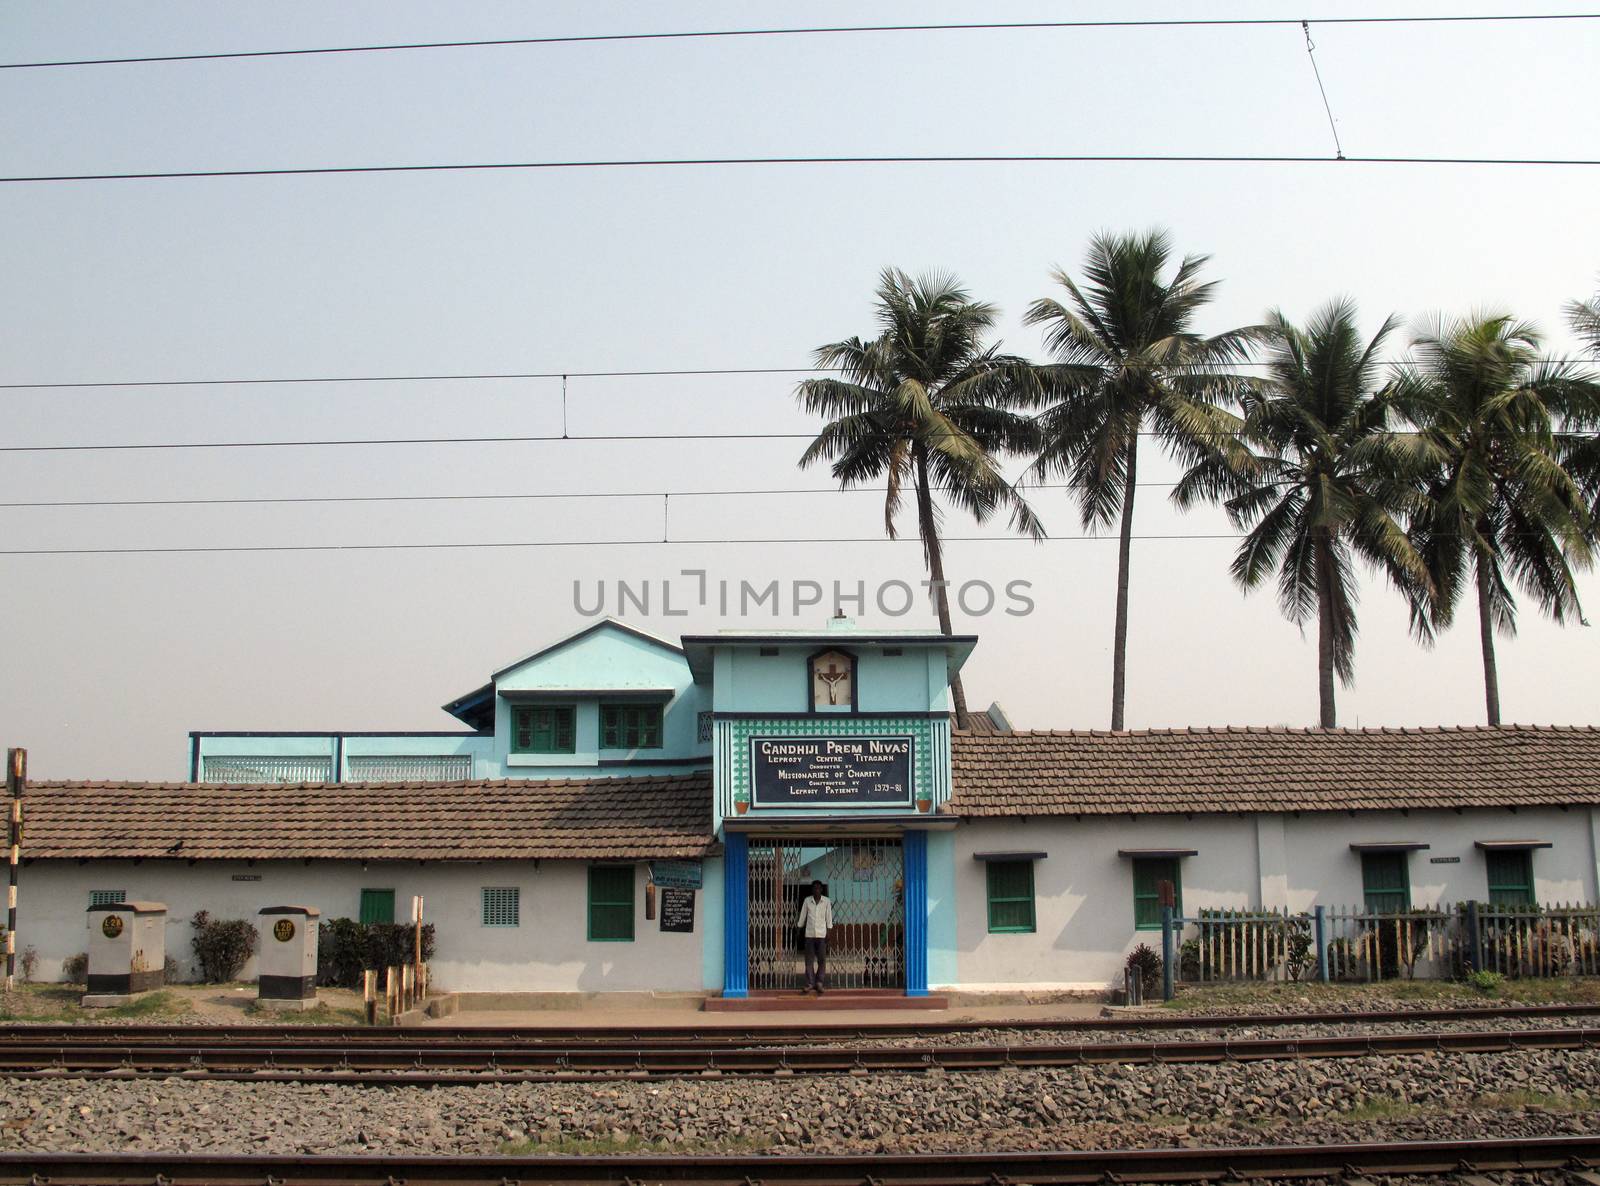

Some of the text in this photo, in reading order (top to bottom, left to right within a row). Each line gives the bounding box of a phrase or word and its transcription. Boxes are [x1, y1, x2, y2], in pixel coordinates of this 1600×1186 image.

[761, 740, 909, 755] GANDHIJI PREM NIVAS
[768, 755, 803, 763] LEPROSY
[815, 755, 843, 763] CENTRE
[778, 769, 830, 780] MISSIONARIES
[847, 769, 882, 778] CHARITY
[790, 785, 819, 795] LEPROSY
[825, 785, 859, 794] PATIENTS
